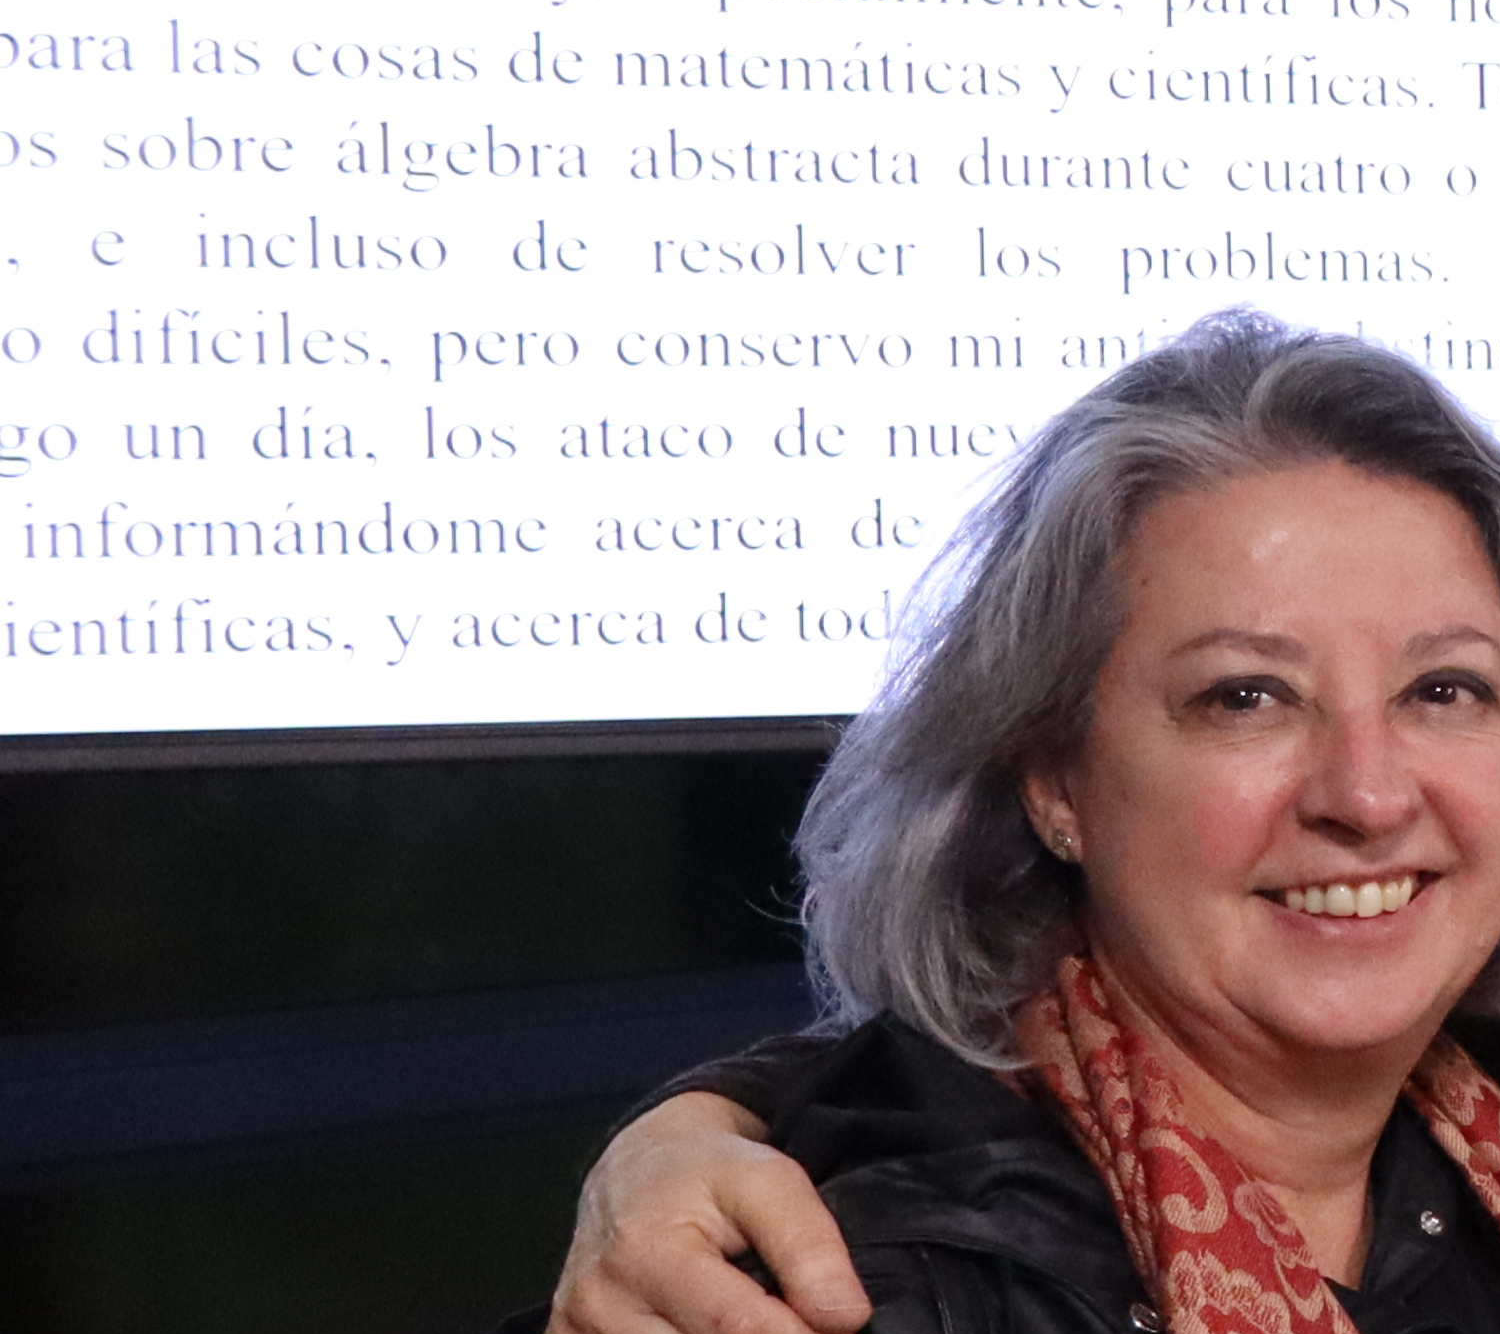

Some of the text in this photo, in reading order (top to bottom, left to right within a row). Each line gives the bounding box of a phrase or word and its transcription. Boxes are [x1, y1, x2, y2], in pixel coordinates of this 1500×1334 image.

[169, 18, 261, 75] las
[291, 42, 479, 81] cosas
[508, 30, 583, 85] de
[614, 41, 1021, 96] matemáticas
[1049, 64, 1081, 114] y
[1108, 50, 1434, 108] científicas.
[103, 115, 294, 173] sobre
[336, 120, 589, 193] álgebra
[629, 128, 920, 185] abstracta
[958, 135, 1190, 191] durante
[1226, 155, 1412, 195] cuatro
[1446, 166, 1478, 196] o
[91, 231, 125, 267] e
[197, 212, 448, 270] incluso
[512, 218, 588, 273] de
[653, 223, 916, 277] resolver
[977, 226, 1061, 278] los
[1121, 230, 1449, 296] problemas.
[82, 308, 392, 370] difíciles,
[431, 331, 580, 383] pero
[616, 332, 913, 368] conservo
[949, 317, 1023, 368] mi
[124, 424, 207, 461] un
[252, 405, 377, 465] día,
[424, 405, 517, 460] los
[559, 416, 734, 459] ataco
[773, 406, 846, 458] de
[23, 500, 547, 559] informándome
[595, 517, 805, 552] acerca
[850, 497, 924, 549] de
[386, 614, 422, 667] y
[452, 611, 667, 649] acerca
[694, 591, 767, 644] de
